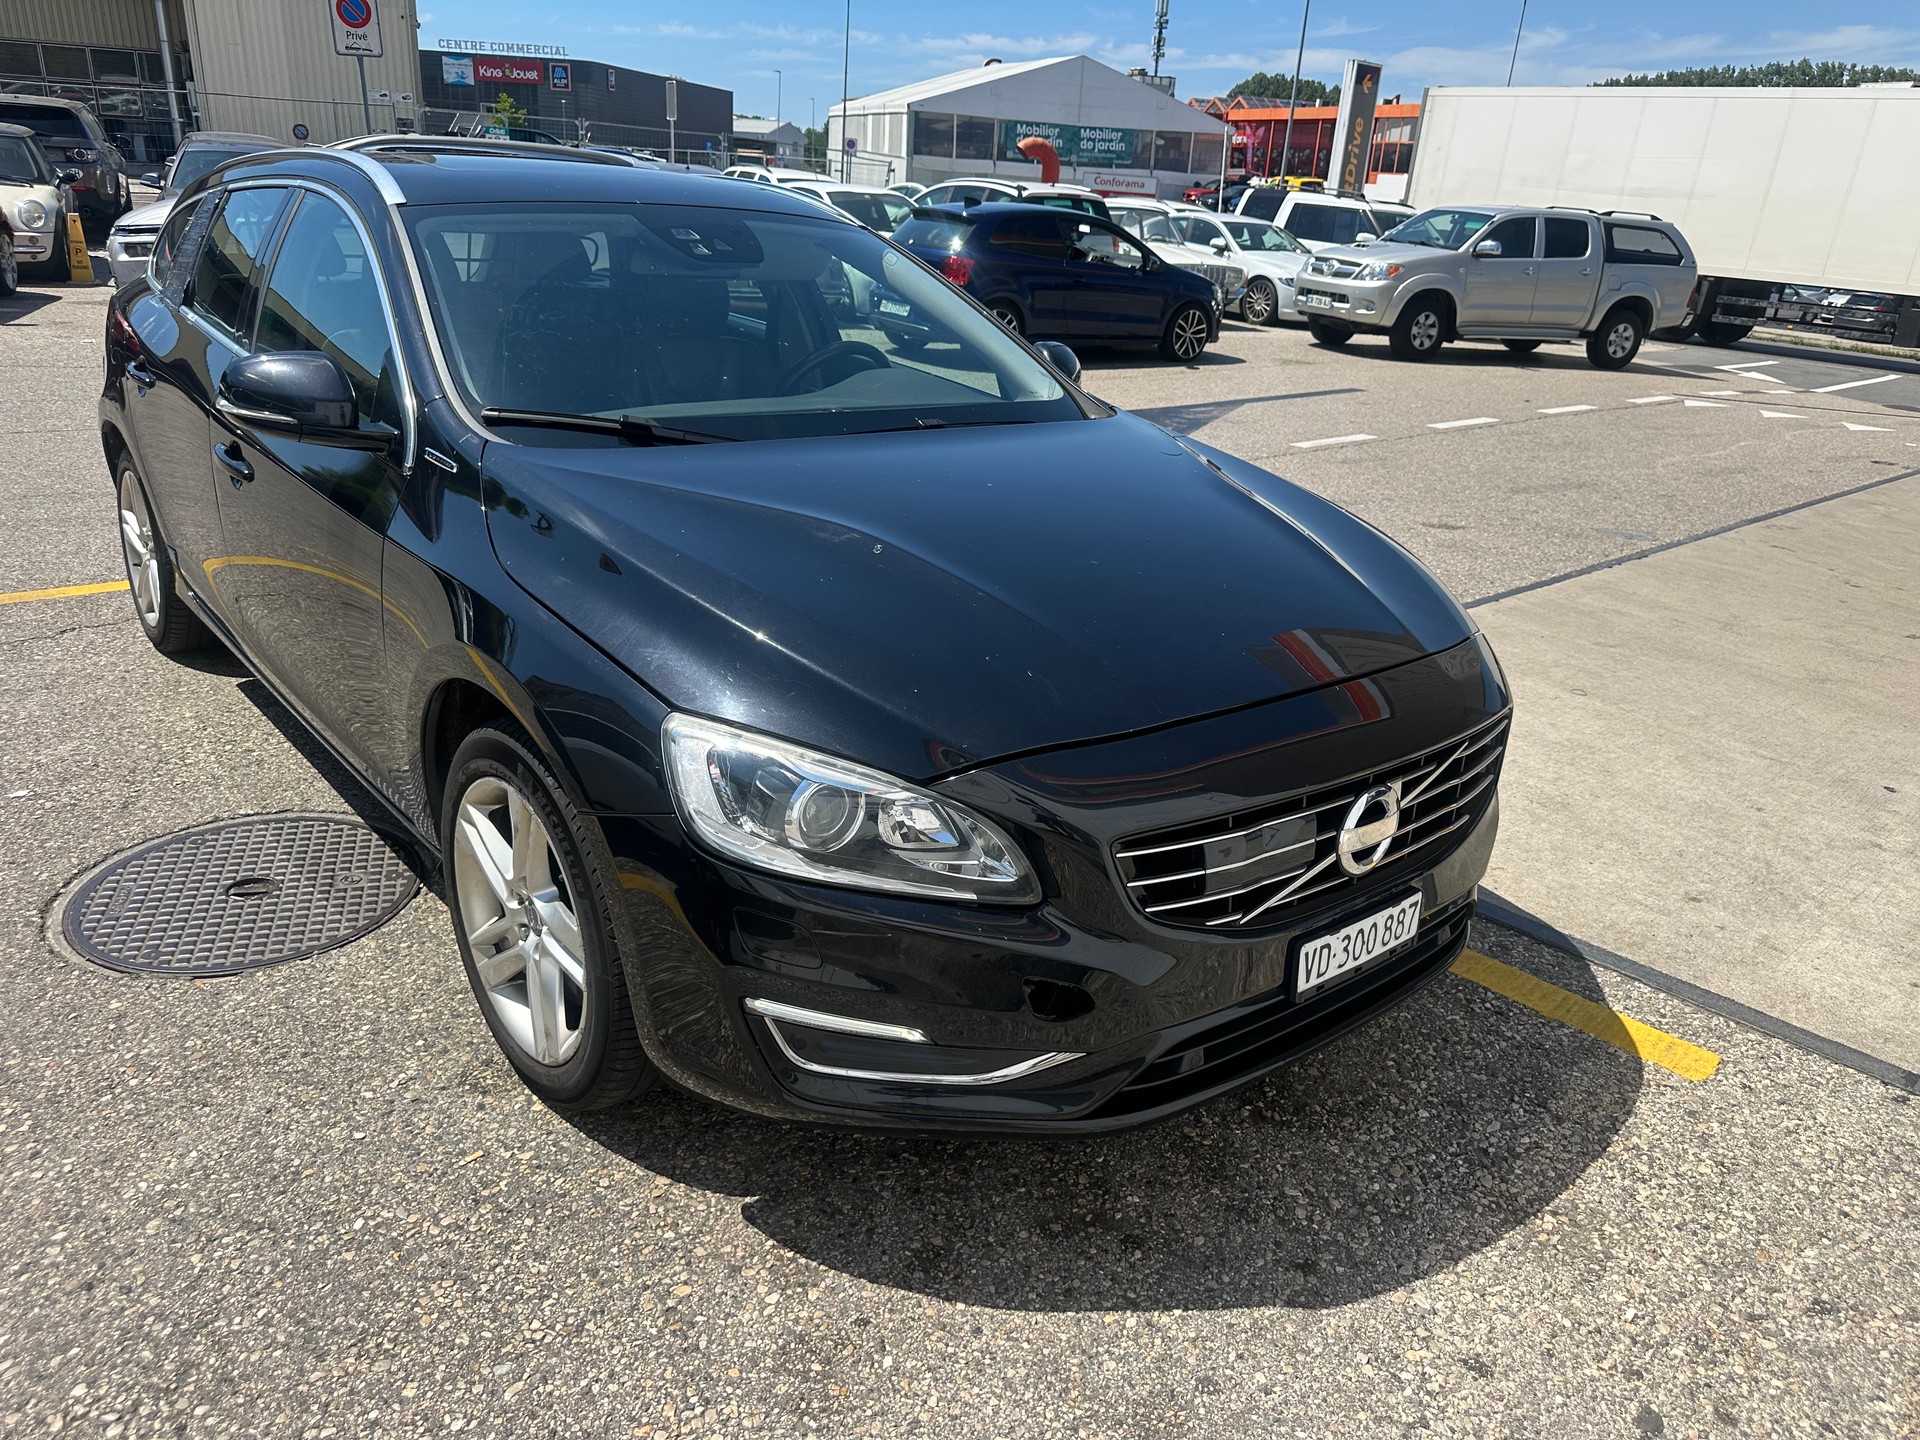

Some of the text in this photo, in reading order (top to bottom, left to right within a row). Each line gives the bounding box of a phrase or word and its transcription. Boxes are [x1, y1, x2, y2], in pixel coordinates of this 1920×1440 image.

[346, 30, 368, 41] Privé
[438, 38, 570, 57] CENTRE COMMERCIAL
[478, 65, 539, 80] King Jouet
[1016, 123, 1060, 136] Mobilier
[1080, 128, 1123, 140] Mobilier
[1080, 138, 1126, 153] de jardin
[1093, 175, 1146, 189] Conforama
